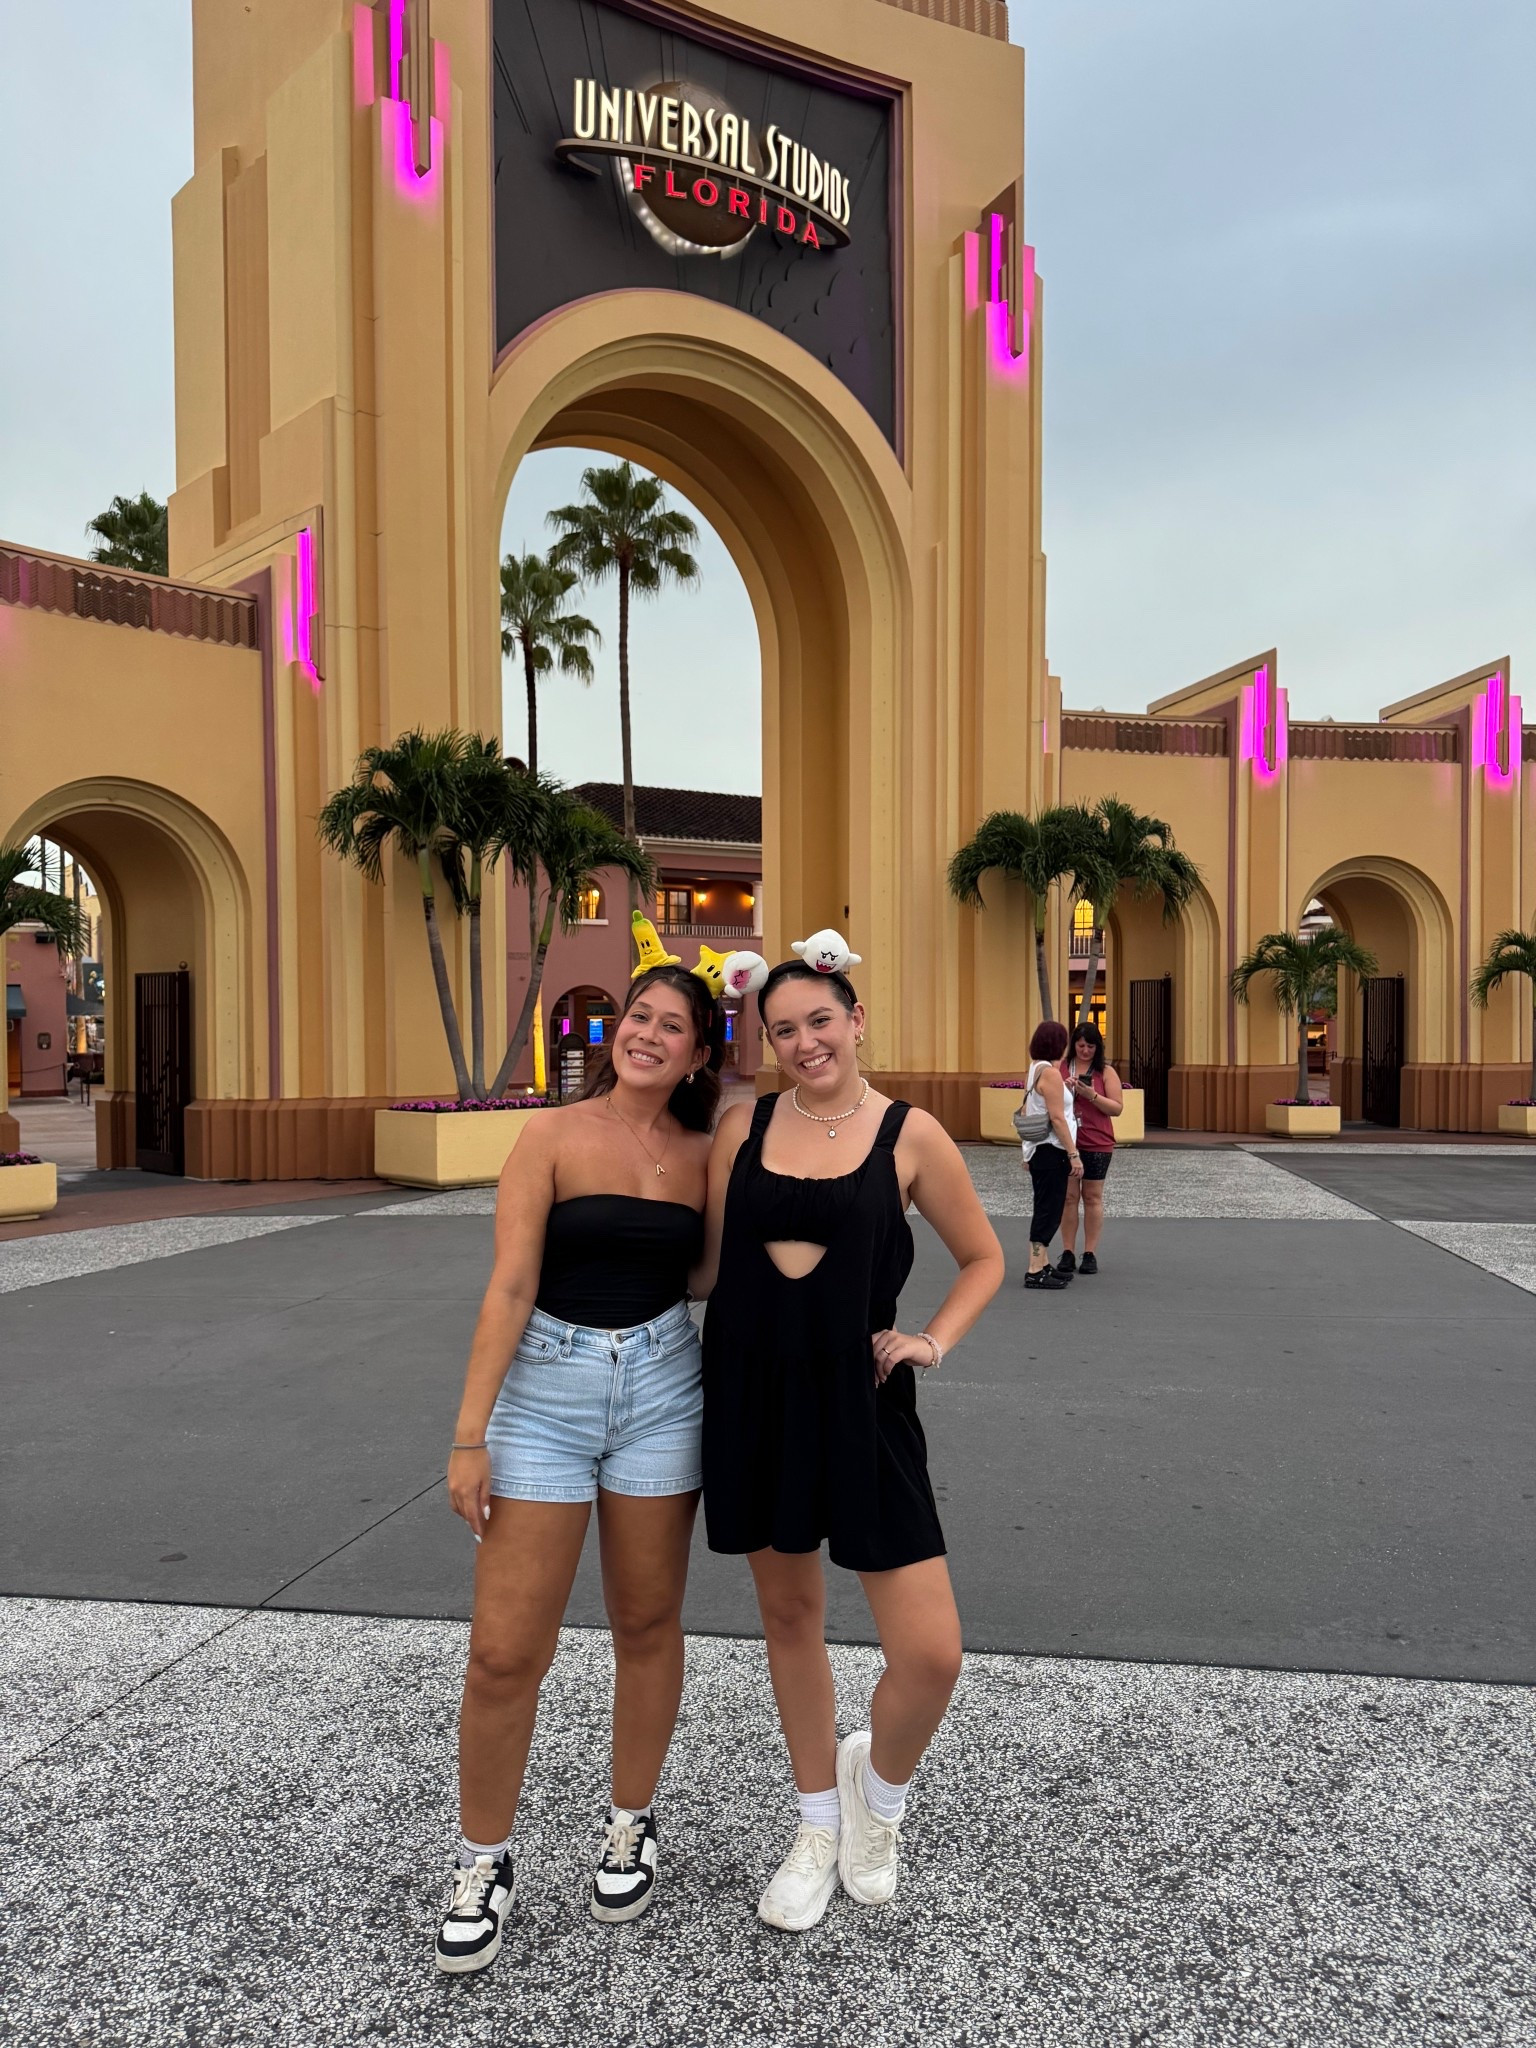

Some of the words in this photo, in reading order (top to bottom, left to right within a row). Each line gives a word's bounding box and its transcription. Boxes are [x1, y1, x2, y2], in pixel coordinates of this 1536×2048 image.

[574, 79, 755, 175] UNIVERSAL
[765, 125, 850, 226] STUDIOS
[633, 164, 819, 249] FLORIDA
